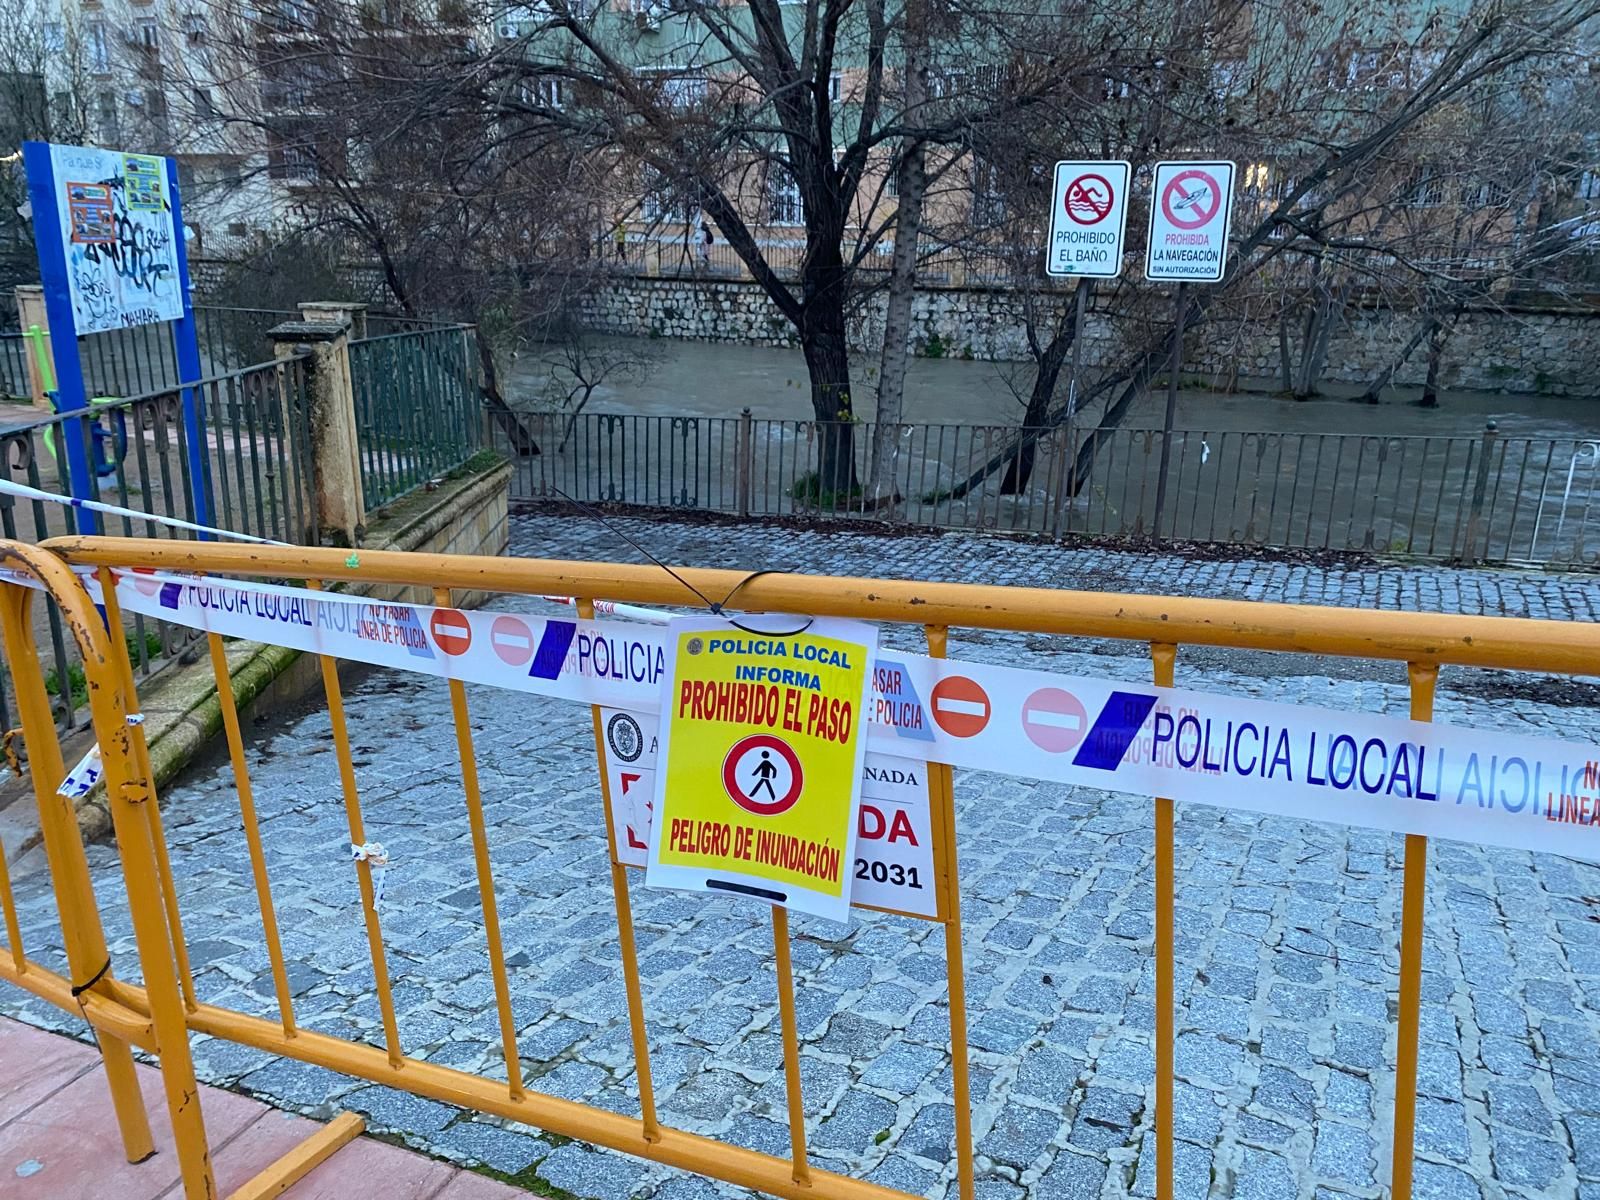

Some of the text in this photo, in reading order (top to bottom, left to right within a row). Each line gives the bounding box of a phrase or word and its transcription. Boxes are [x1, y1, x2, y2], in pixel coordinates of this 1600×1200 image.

[1056, 231, 1115, 244] PROHIBIDO
[1165, 233, 1209, 246] PROHIBIDA
[1060, 246, 1107, 262] EL BAÑO
[1153, 247, 1218, 262] LA NAVEGACIÓN
[1165, 266, 1216, 274] AUTORIZACIÓN
[382, 624, 393, 644] DE
[394, 626, 428, 650] POLICIA
[578, 634, 665, 684] POLICIA
[709, 639, 787, 657] POLICIA
[793, 643, 851, 670] LOCAL
[735, 665, 821, 691] INFORMA
[872, 667, 902, 696] ASAR
[679, 680, 779, 728] PROHIBIDO
[783, 688, 802, 733] EL
[807, 693, 852, 745] PASO
[876, 700, 923, 730] POLICIA
[1152, 712, 1436, 802] POLICIA LOCAL
[863, 766, 919, 786] NADA
[1583, 760, 1600, 790] N
[858, 804, 919, 847] DA
[670, 818, 840, 883] PELIGRO DE INUNDACIÓN
[855, 858, 923, 890] 2031
